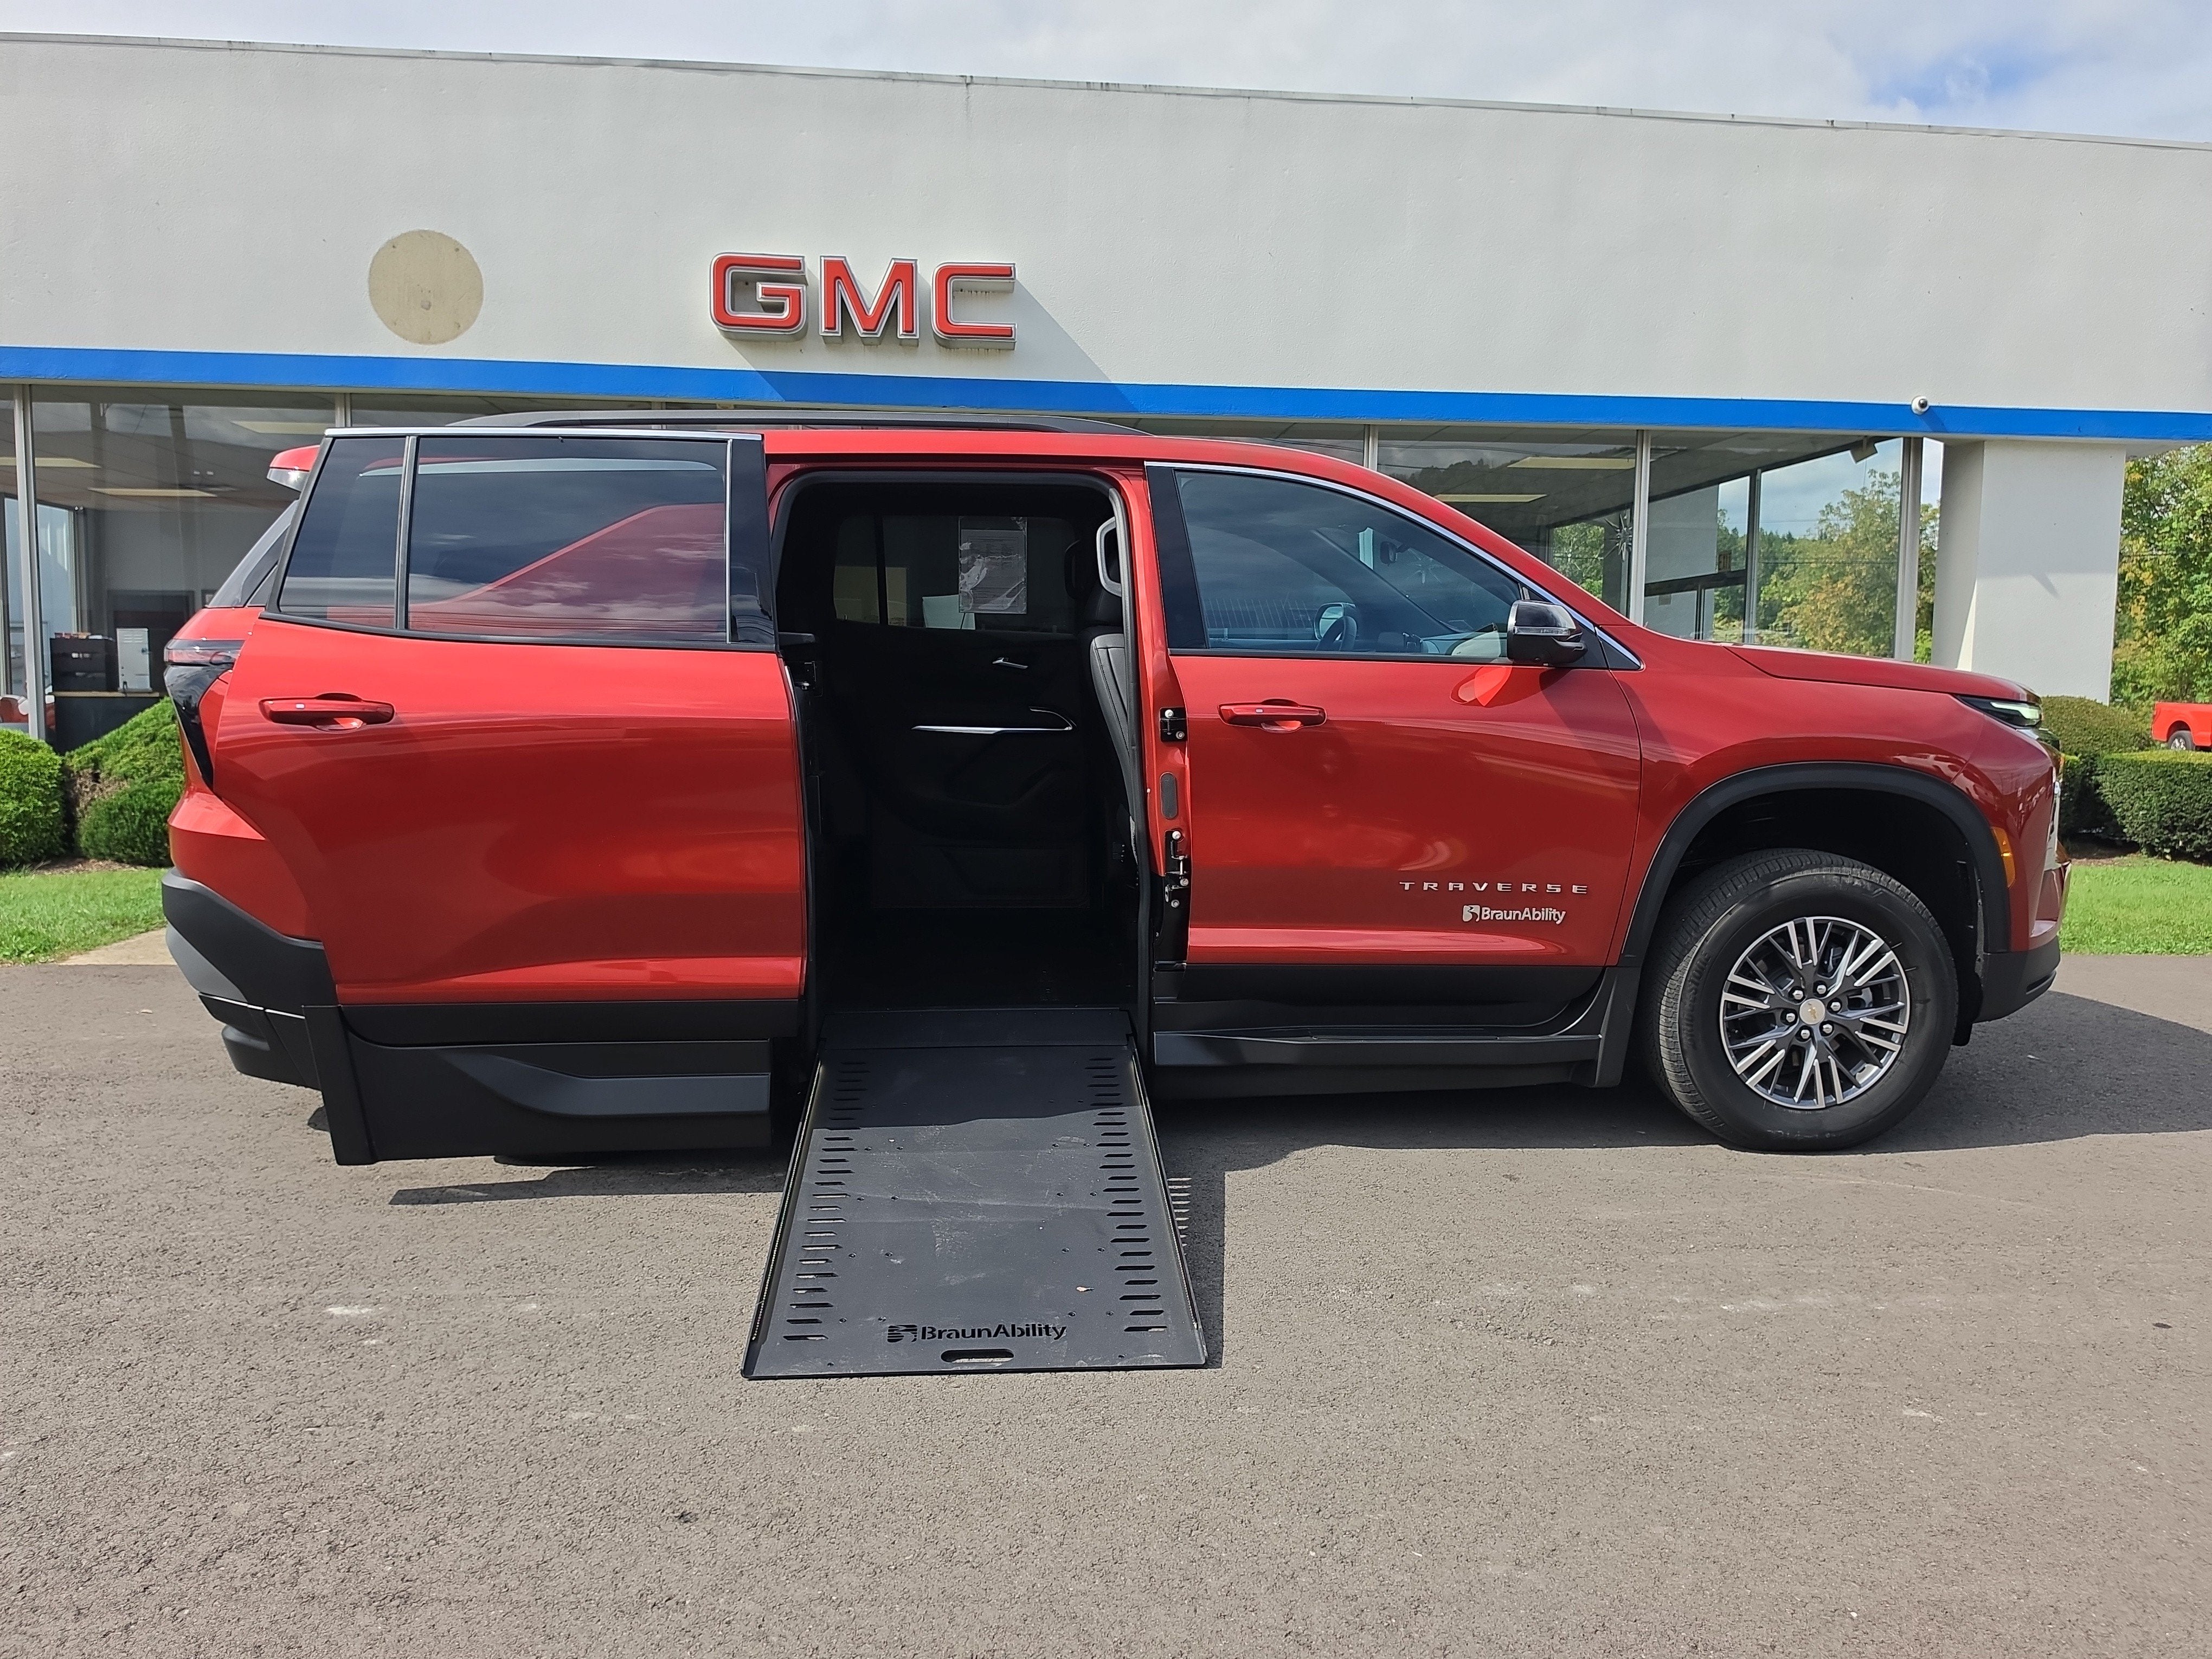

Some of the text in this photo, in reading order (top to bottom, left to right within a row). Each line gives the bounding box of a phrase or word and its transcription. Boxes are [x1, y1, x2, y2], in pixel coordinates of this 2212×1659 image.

[709, 252, 1017, 344] GMC
[1399, 882, 1589, 895] TRAVERSE
[1481, 906, 1567, 924] BraunAbility
[921, 1323, 1067, 1341] BraunAbility
